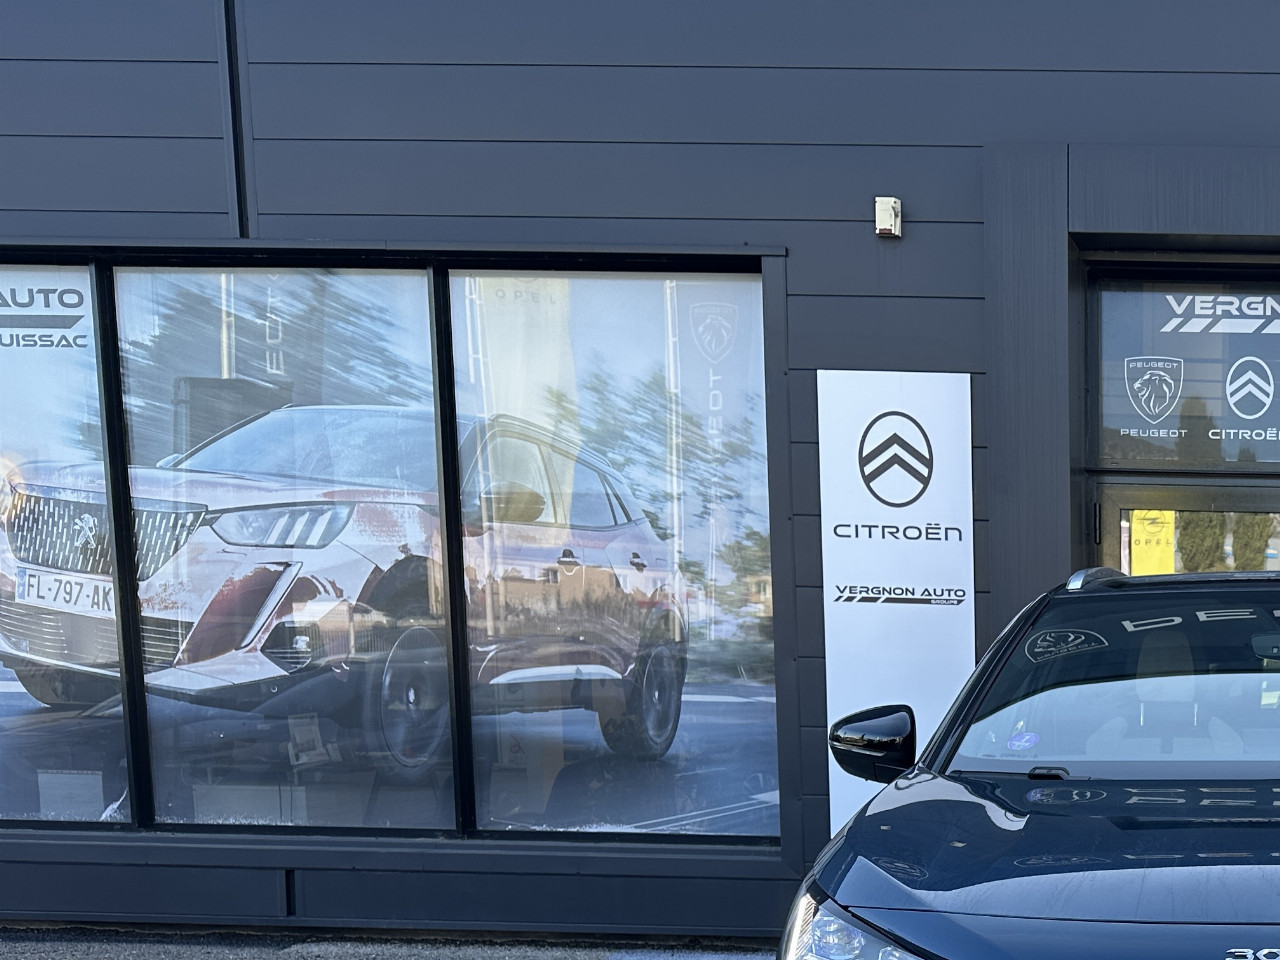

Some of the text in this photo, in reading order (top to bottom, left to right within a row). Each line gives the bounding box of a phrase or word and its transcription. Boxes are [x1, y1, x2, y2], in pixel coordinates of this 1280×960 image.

[1129, 361, 1179, 369] PEUGEOT
[1120, 428, 1188, 438] PEUGEOT
[834, 523, 963, 541] CITROËN
[1134, 538, 1174, 547] OPEL
[27, 573, 112, 612] FL-797-AK
[834, 585, 966, 598] VERGNON AUTO
